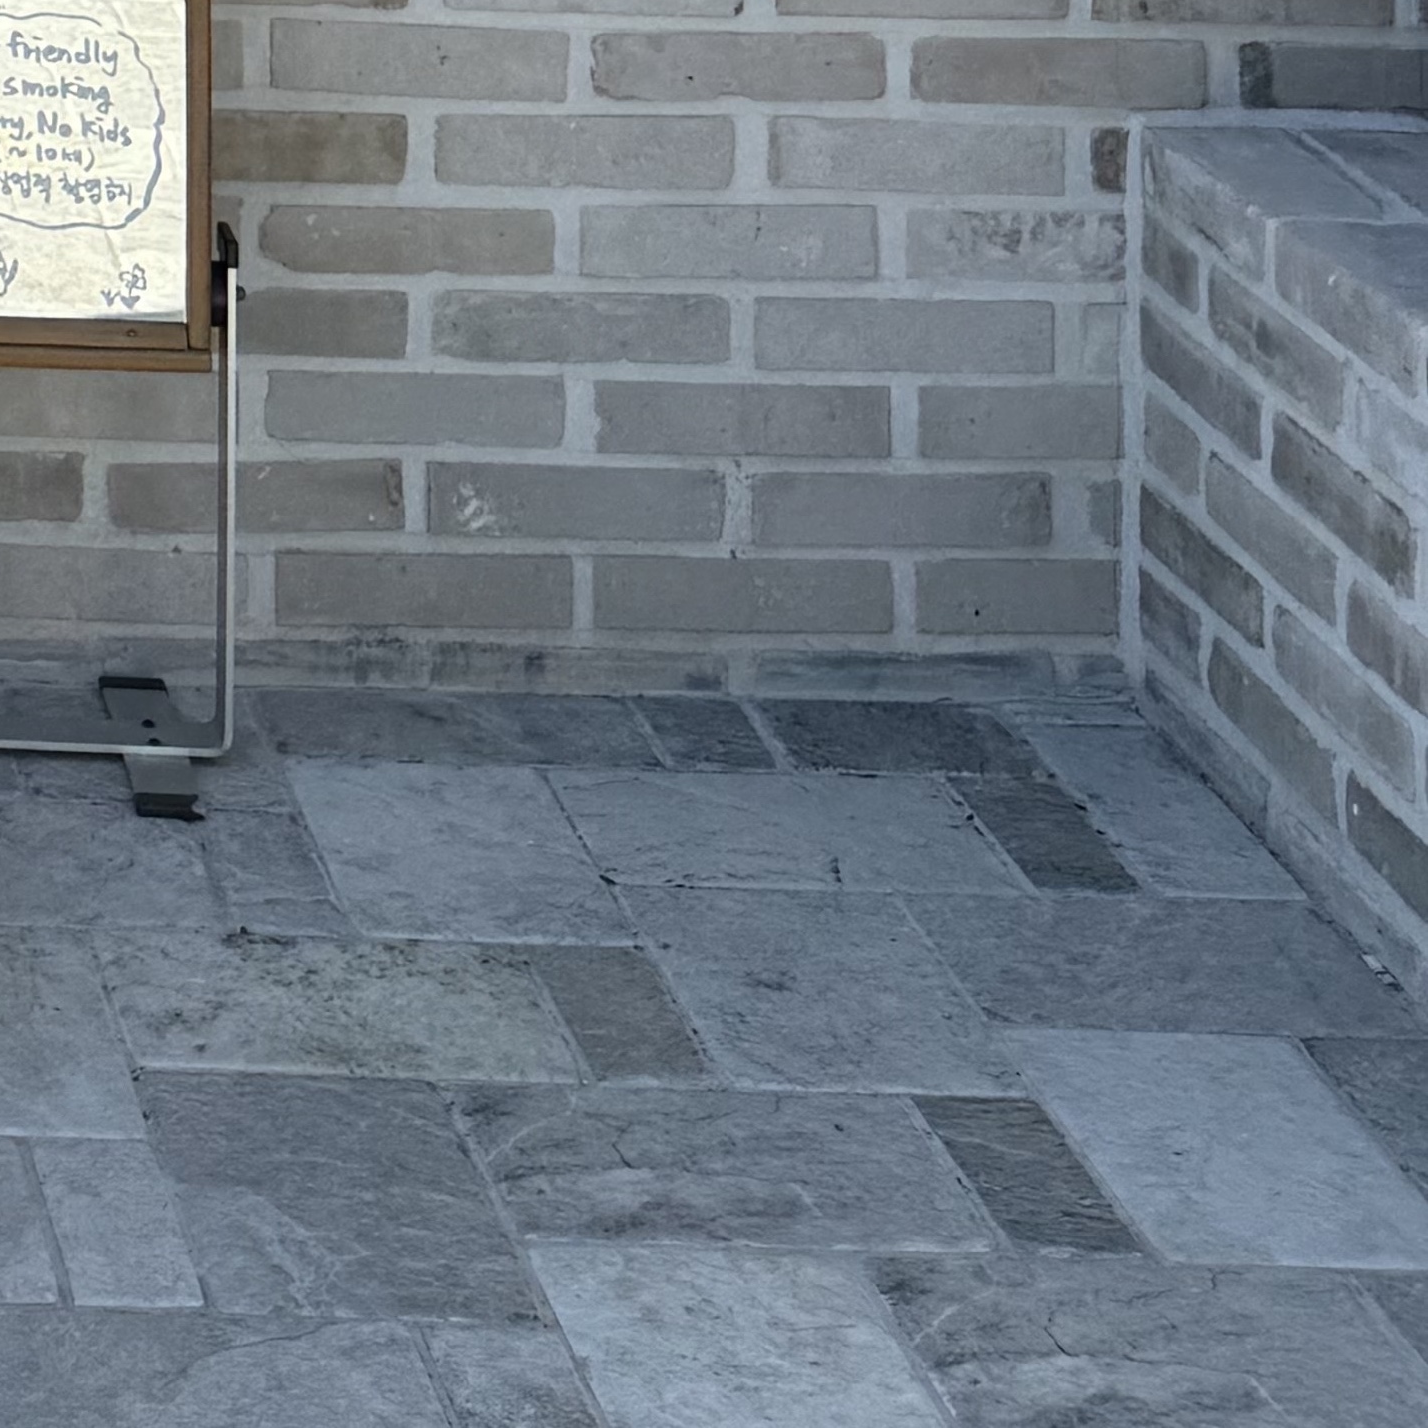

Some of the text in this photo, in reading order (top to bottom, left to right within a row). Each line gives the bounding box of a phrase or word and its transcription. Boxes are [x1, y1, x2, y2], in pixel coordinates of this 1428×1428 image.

[7, 30, 119, 77] friendly
[2, 76, 115, 114] smoking
[37, 110, 73, 138] No
